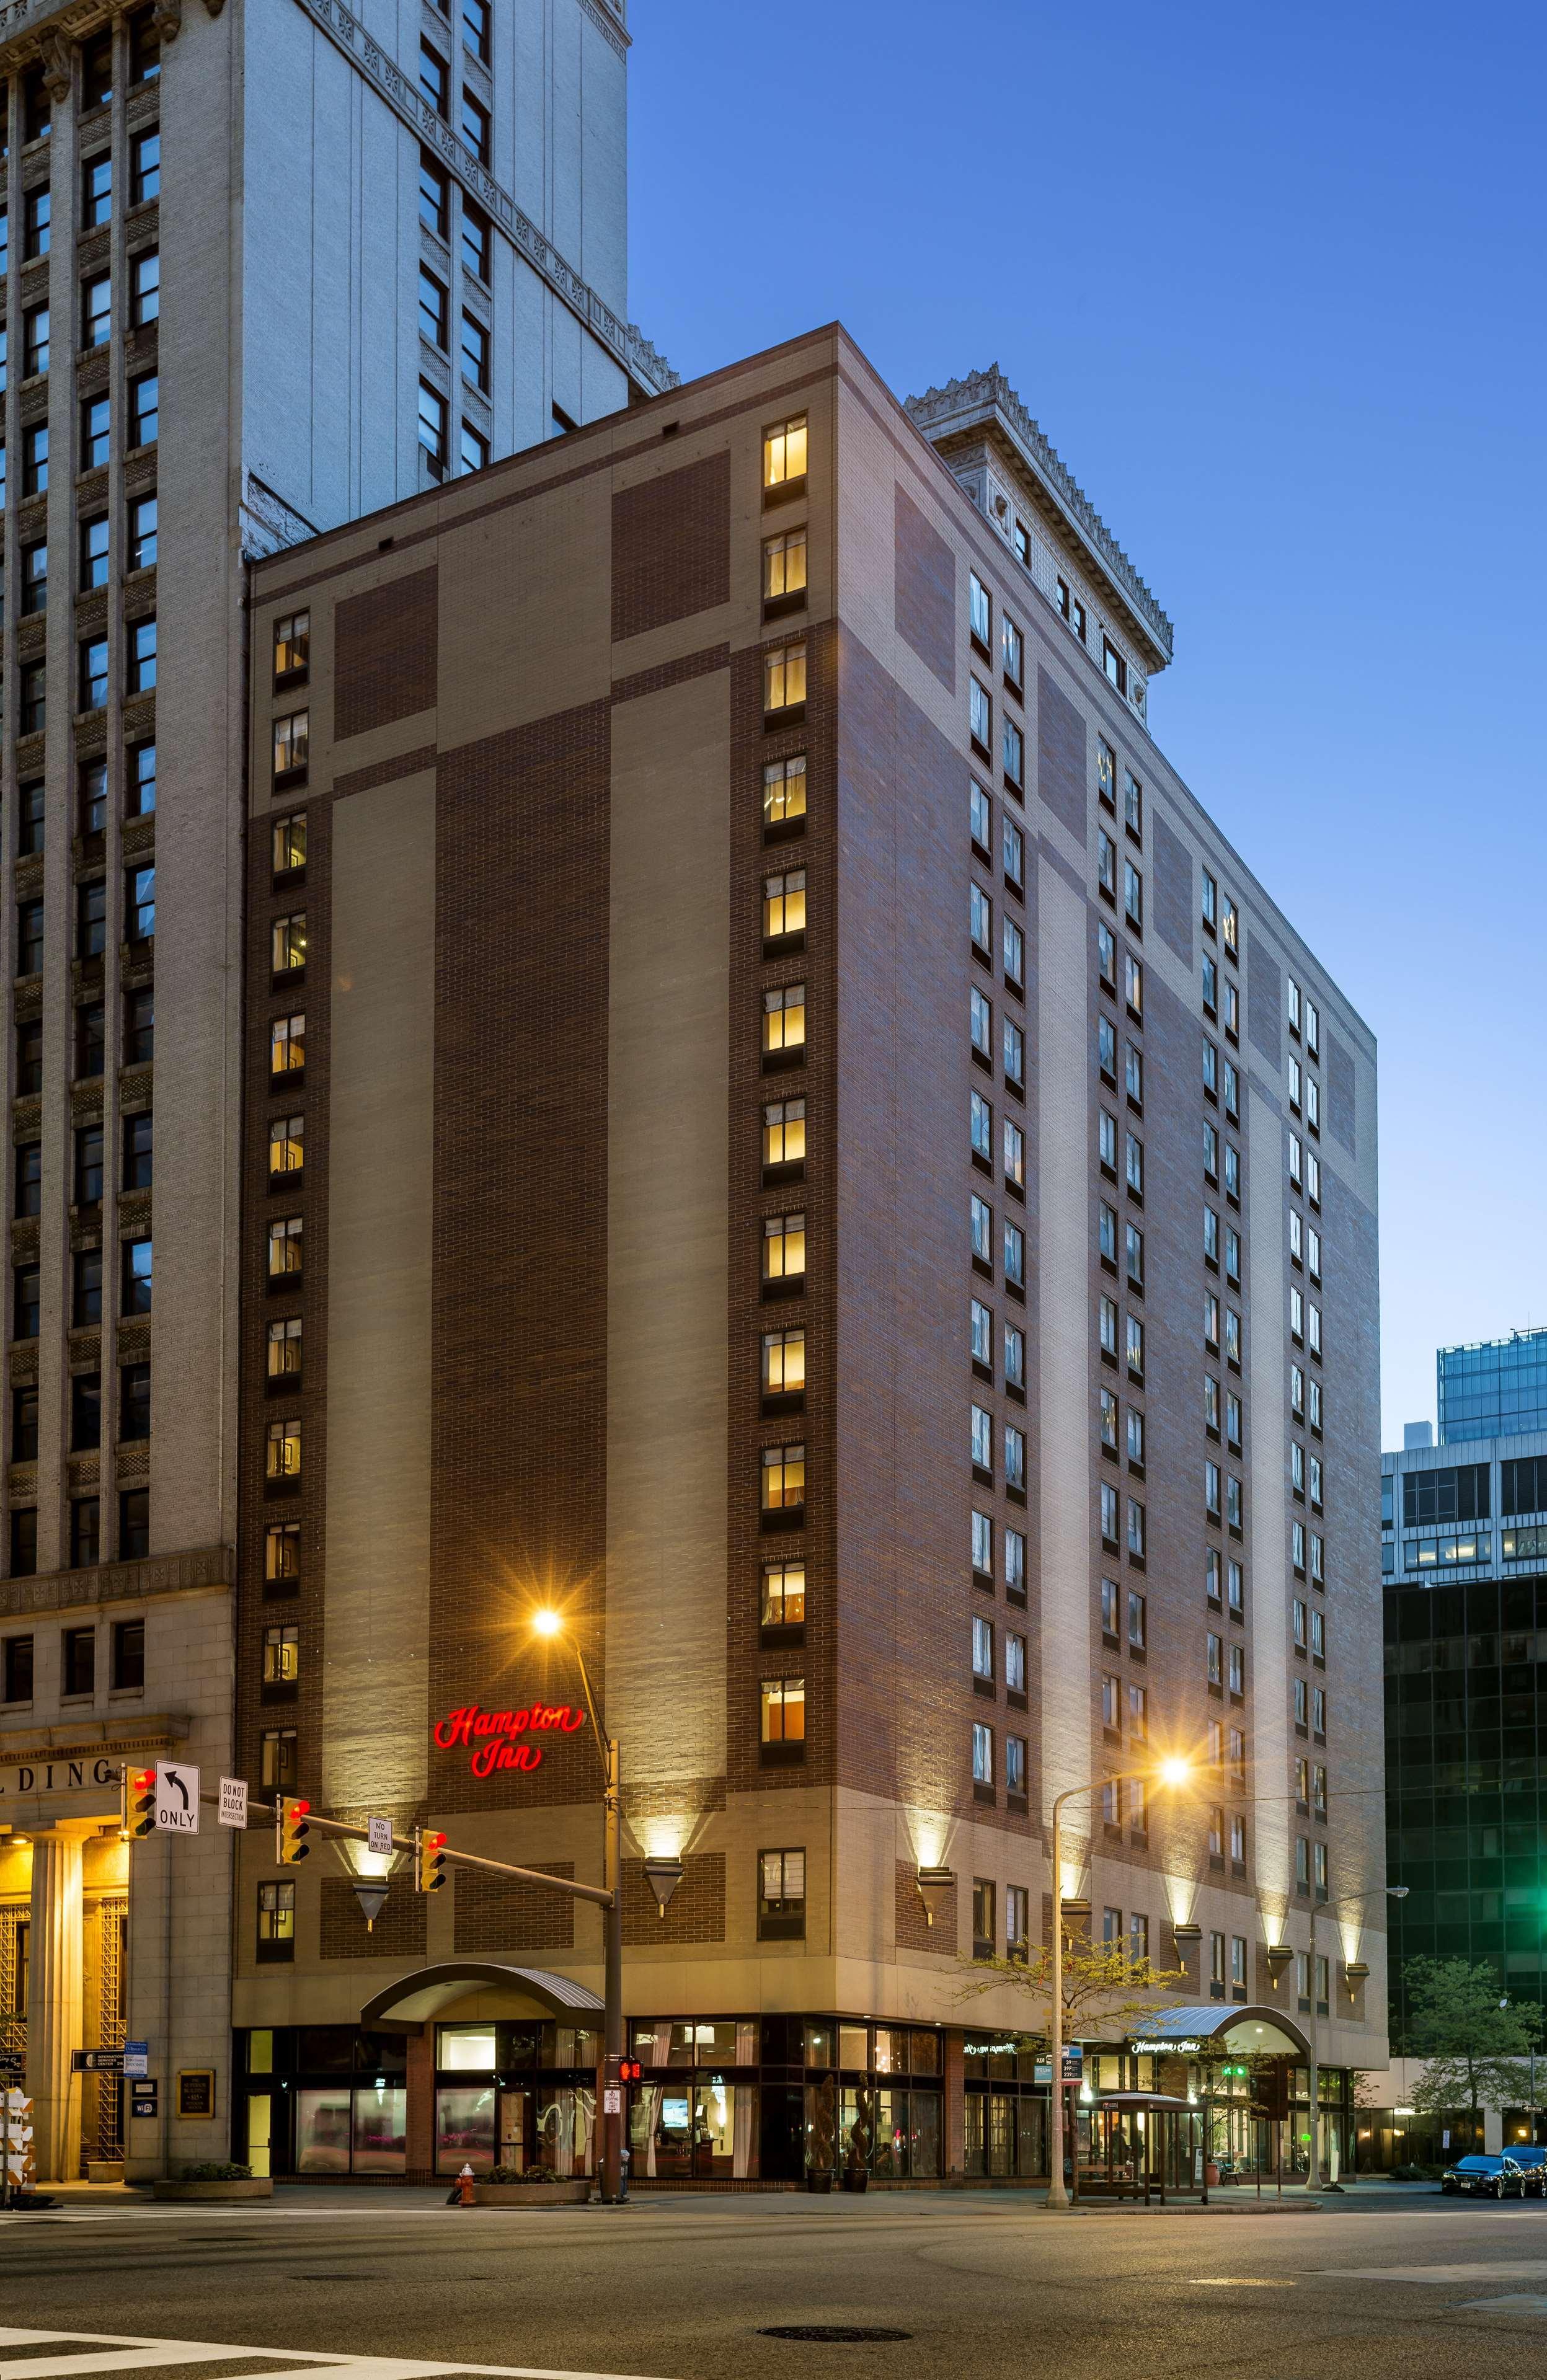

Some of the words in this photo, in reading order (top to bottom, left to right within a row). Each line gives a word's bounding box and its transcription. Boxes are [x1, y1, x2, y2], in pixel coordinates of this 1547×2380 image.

[435, 1702, 585, 1748] Hampton
[472, 1738, 541, 1777] Inn
[223, 1784, 231, 1795] DO
[233, 1787, 245, 1798] NOT
[223, 1798, 243, 1812] BLOCK
[160, 1810, 195, 1827] ONLY
[221, 1811, 244, 1821] INTERSECTION
[374, 1831, 388, 1840] TURN
[380, 1843, 391, 1851] RED
[1132, 2042, 1176, 2053] Hampton
[1177, 2041, 1200, 2052] Inn
